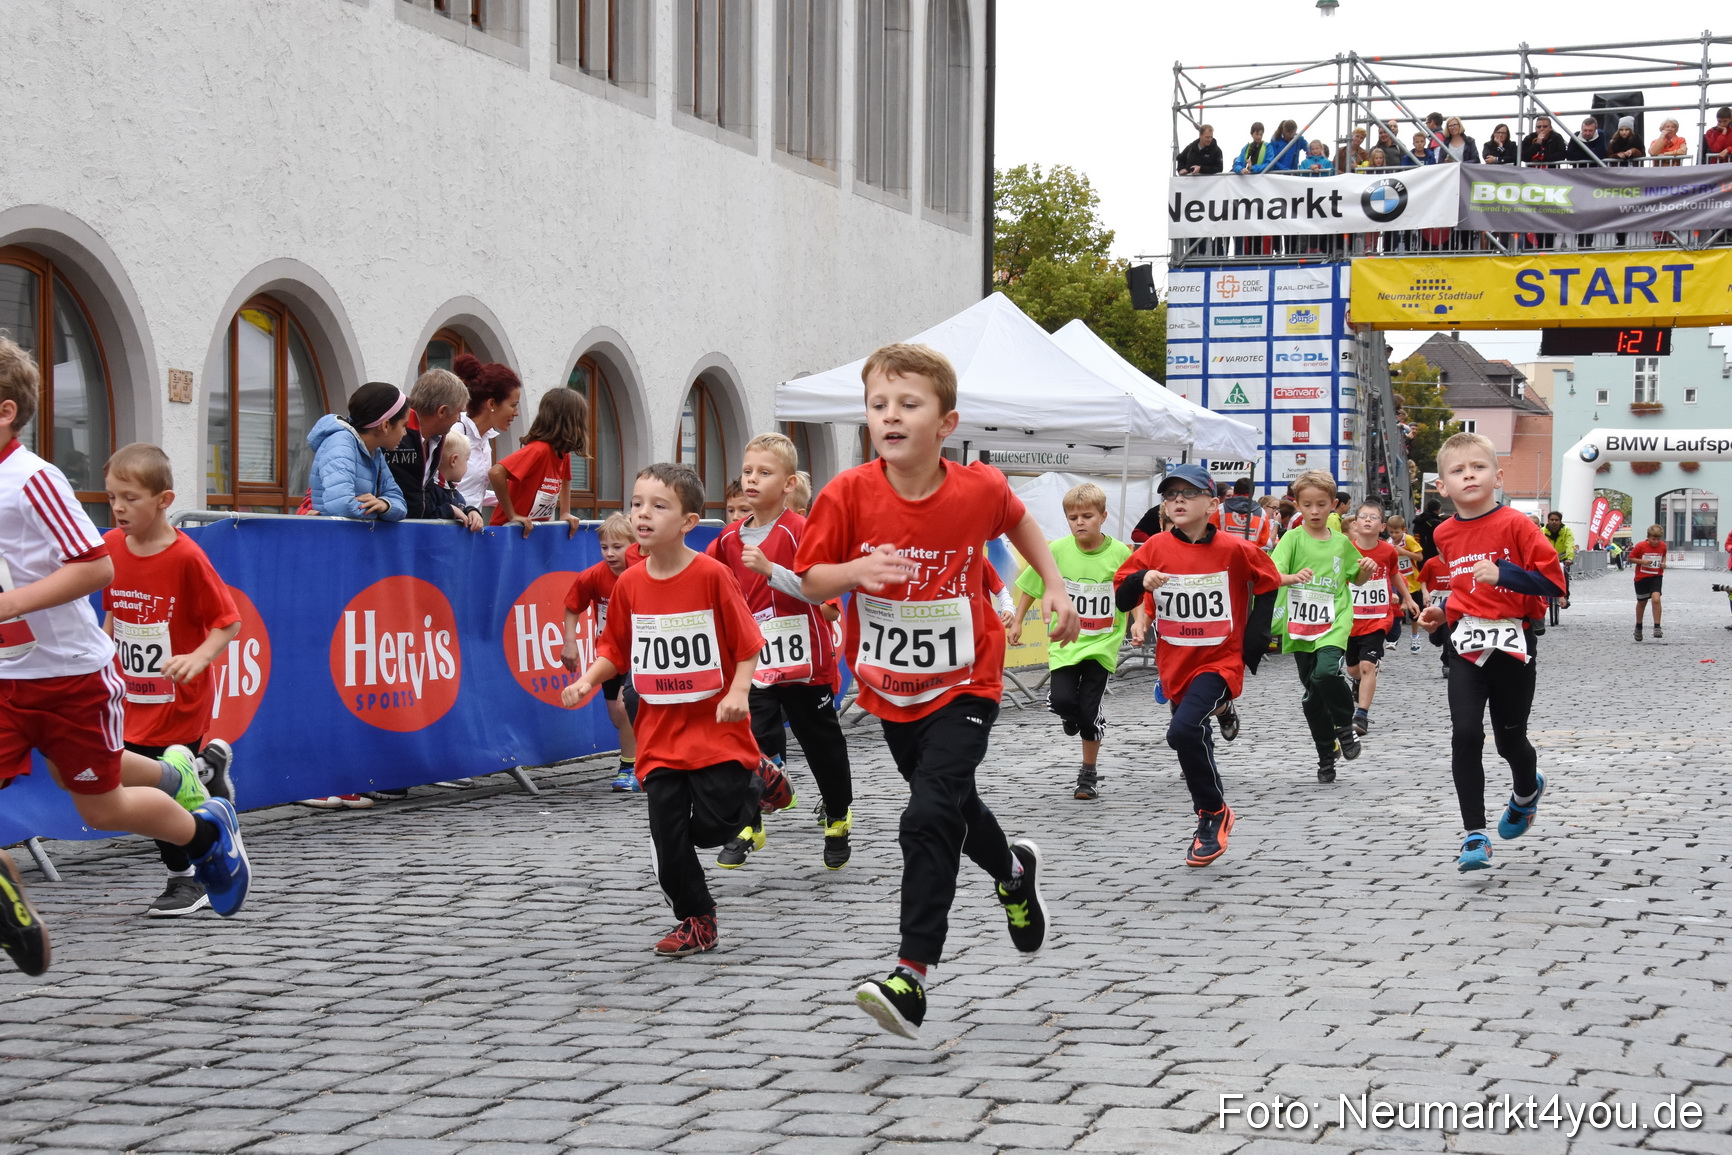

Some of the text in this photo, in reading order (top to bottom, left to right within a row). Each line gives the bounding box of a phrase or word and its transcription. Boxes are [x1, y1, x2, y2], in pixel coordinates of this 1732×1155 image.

[1472, 183, 1573, 205] BOCK
[1593, 187, 1641, 199] OFFICE
[1645, 184, 1717, 198] INDUSTRY
[1169, 187, 1343, 223] Neumarkt
[1470, 205, 1500, 213] inspired
[1513, 263, 1695, 307] START
[1378, 291, 1484, 301] Neumarkter Stadtlauf
[1225, 355, 1264, 363] VARIOTEC
[1606, 436, 1659, 451] BMW
[383, 452, 418, 464] CAMP
[1210, 461, 1245, 471] swn
[1590, 501, 1607, 534] REWE
[1601, 513, 1621, 540] REWE
[860, 542, 940, 560] Nearkter
[1185, 575, 1223, 587] BOCK
[1161, 590, 1224, 619] 7003
[1352, 589, 1386, 604] 7196
[900, 603, 961, 618] BOCK
[1292, 601, 1331, 623] 7404
[660, 613, 707, 629] BOCK
[764, 618, 802, 631] BOCK
[125, 625, 161, 636] BOCK
[1179, 625, 1204, 636] Jona
[514, 603, 598, 678] Hevi
[869, 621, 958, 668] 7251
[344, 610, 456, 700] Hervis
[638, 633, 712, 669] 7090
[532, 673, 580, 693] SPOR
[655, 678, 694, 692] Niklas
[763, 672, 786, 682] Felix
[882, 674, 944, 693] Dominik
[356, 690, 415, 711] SPORTS
